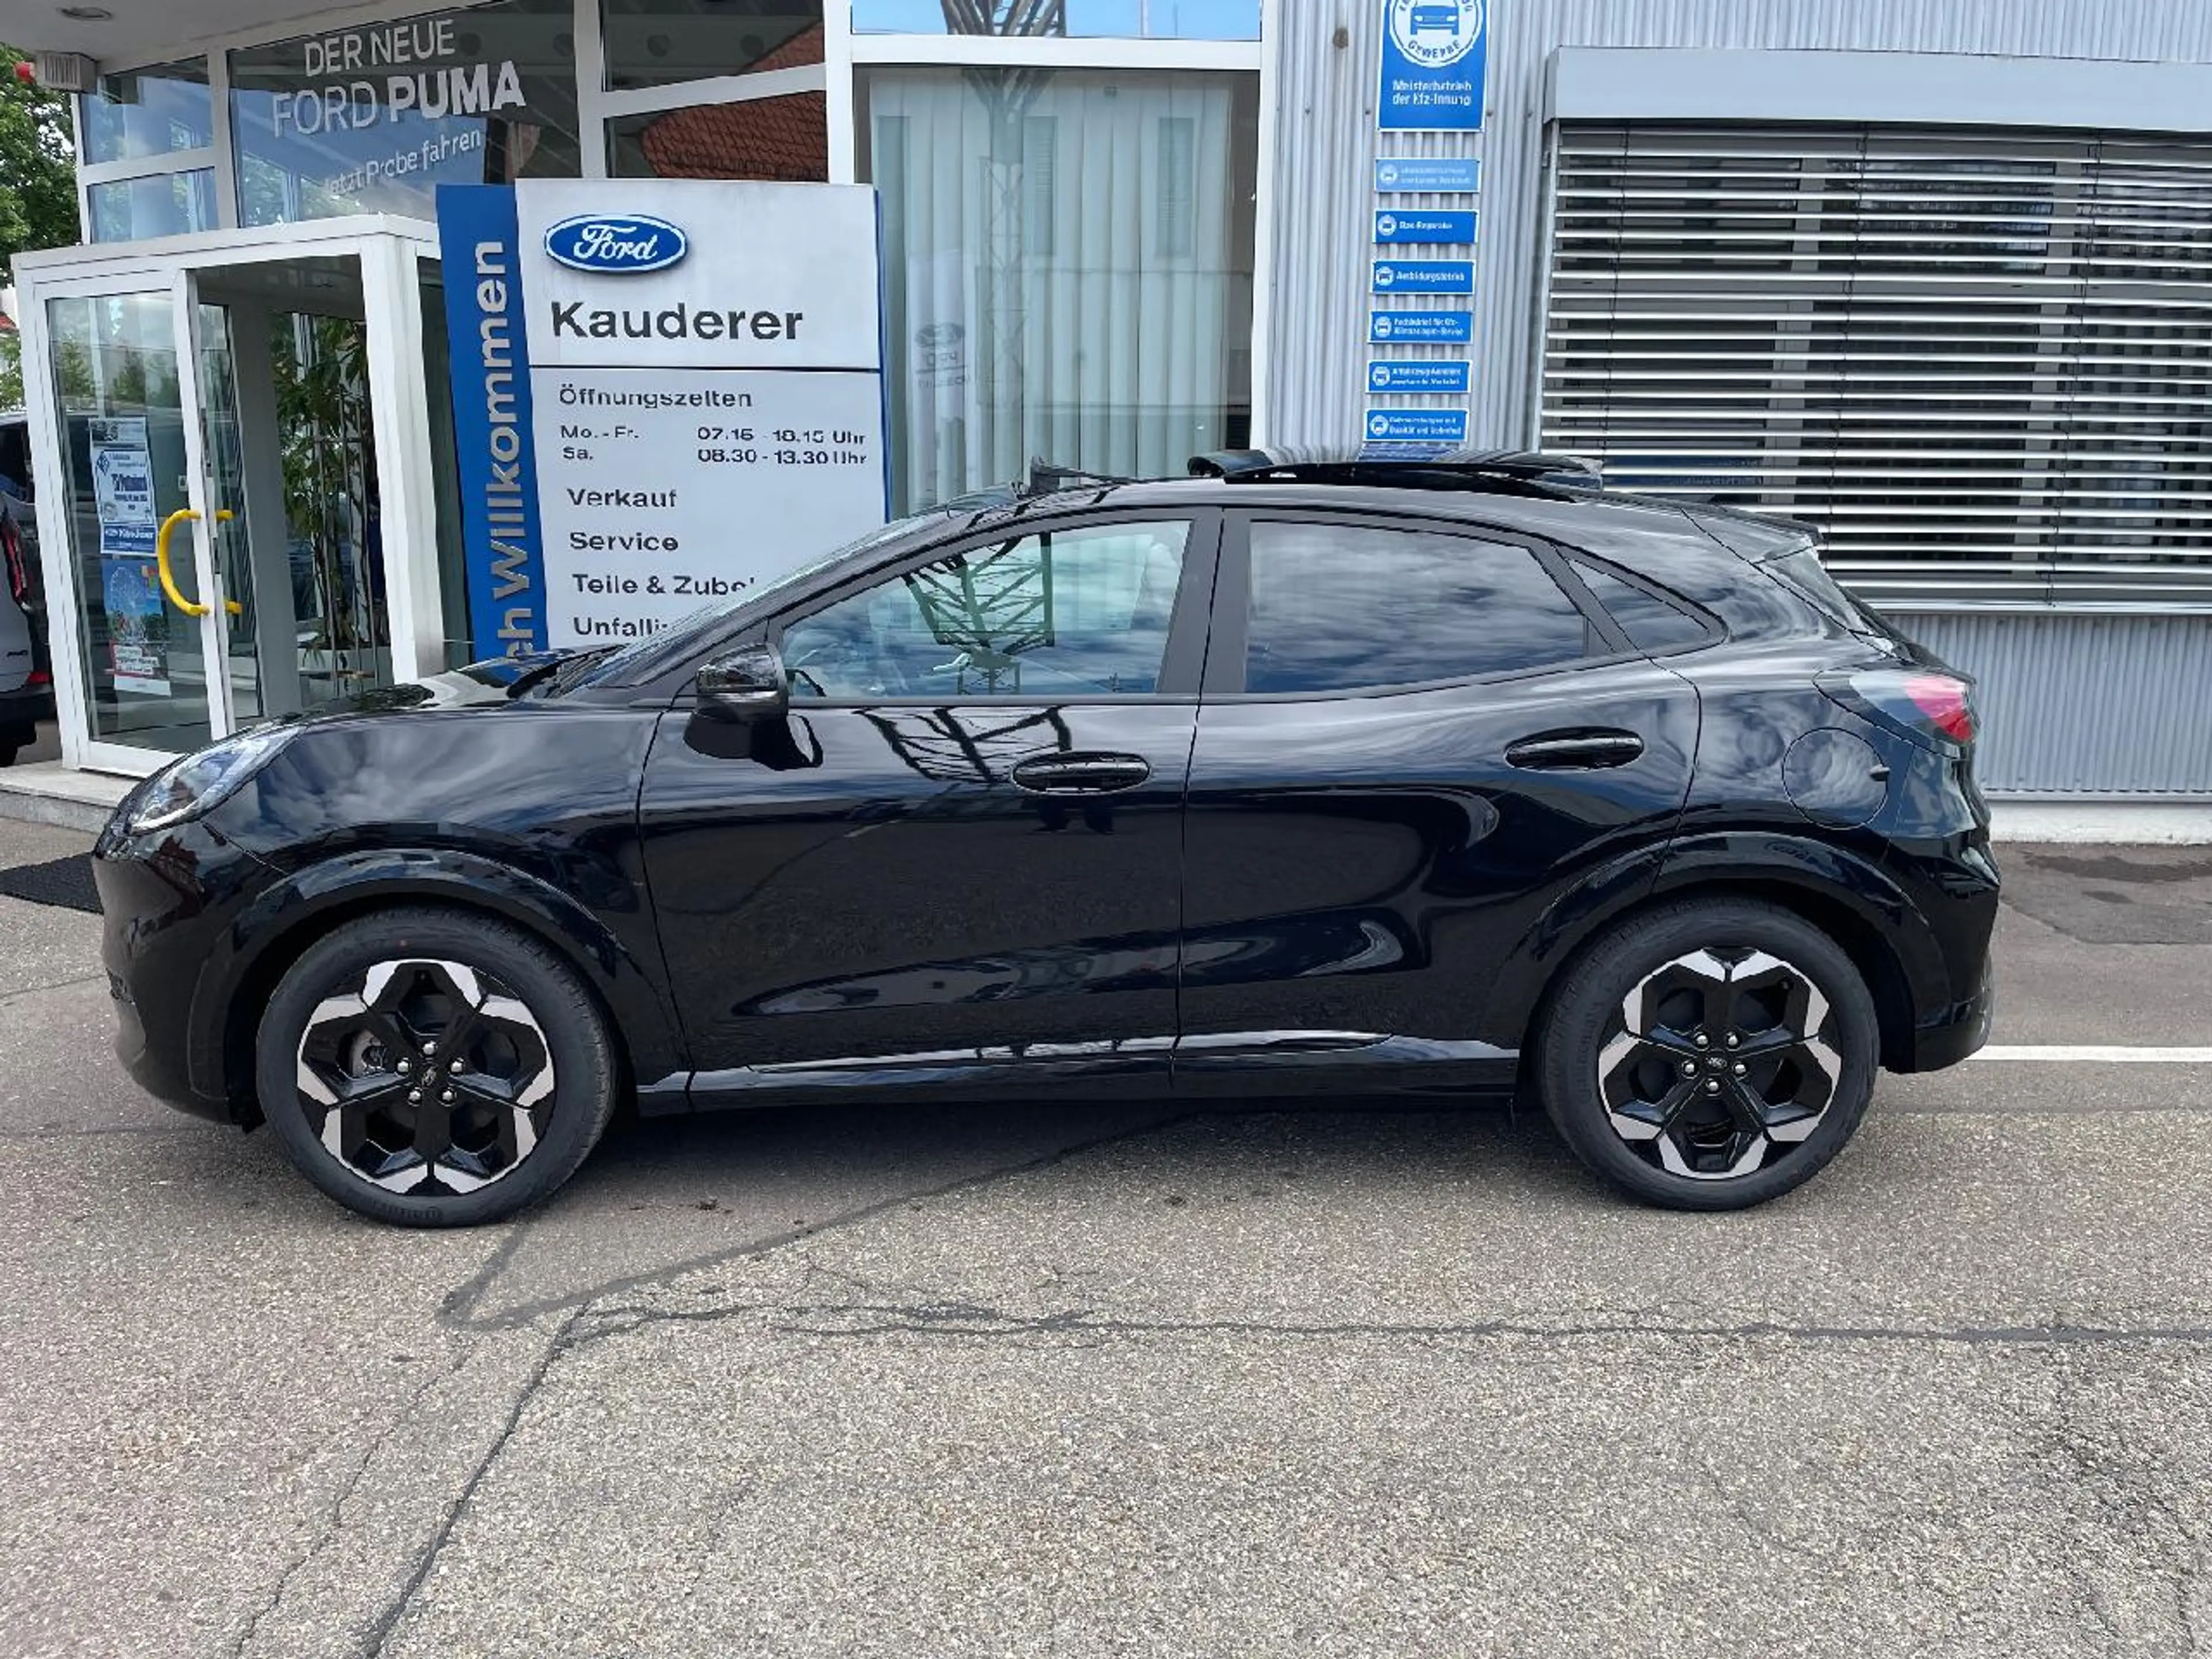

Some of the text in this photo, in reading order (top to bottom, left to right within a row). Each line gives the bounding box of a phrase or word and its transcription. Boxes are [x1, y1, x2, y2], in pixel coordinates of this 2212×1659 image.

[305, 19, 456, 77] DER NEUE
[273, 60, 527, 138] FORD PUMA
[1392, 93, 1410, 105] der
[366, 150, 418, 184] Probe
[422, 128, 483, 171] fahren
[573, 223, 660, 261] Ford
[551, 301, 804, 340] Kauderer
[475, 241, 531, 601] Willkommen
[560, 425, 599, 439] Mo.
[614, 426, 639, 439] Fr.
[832, 430, 866, 445] Uhr
[562, 445, 594, 461] Sa.
[697, 449, 757, 463] 08.30
[774, 450, 829, 464] 13.30
[566, 487, 677, 508] Verkauf
[569, 531, 679, 552] Service
[571, 573, 638, 595] Teile
[646, 575, 666, 594] &
